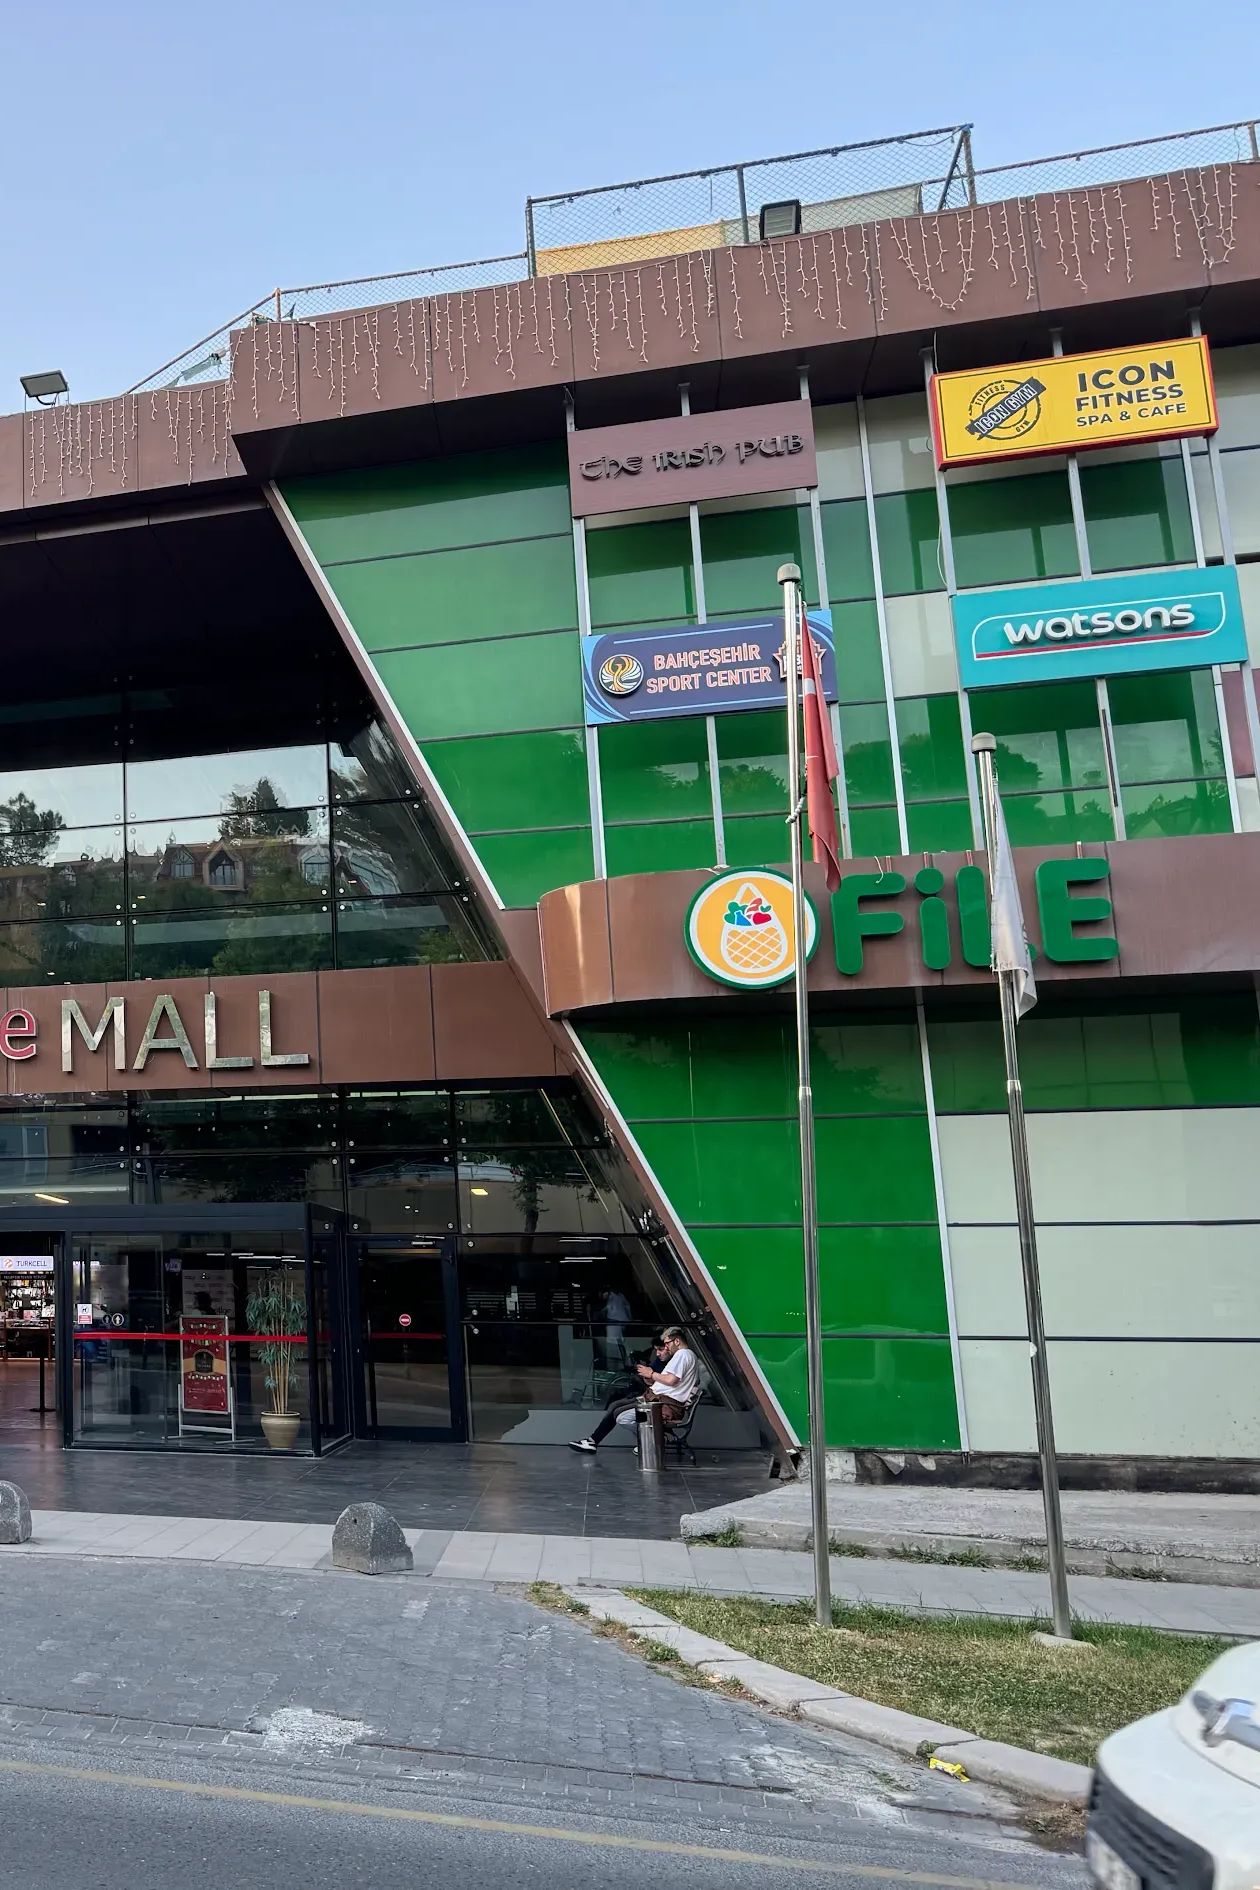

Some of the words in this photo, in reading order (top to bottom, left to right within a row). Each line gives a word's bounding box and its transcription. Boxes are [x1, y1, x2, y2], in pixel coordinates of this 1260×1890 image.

[1077, 359, 1176, 393] ICON
[974, 404, 1011, 434] ICON
[1004, 383, 1037, 411] GYM
[975, 384, 1005, 406] FITNESS
[1075, 383, 1184, 412] FITNESS
[1015, 420, 1030, 432] GYM
[1076, 409, 1113, 427] SPA
[1119, 410, 1132, 421] &
[1136, 402, 1187, 418] CAFE
[1003, 603, 1195, 645] watsons
[653, 643, 761, 671] BAHÇEŞEHİR
[646, 673, 702, 694] SPORT
[706, 667, 772, 688] CENTER
[61, 990, 311, 1073] MALL
